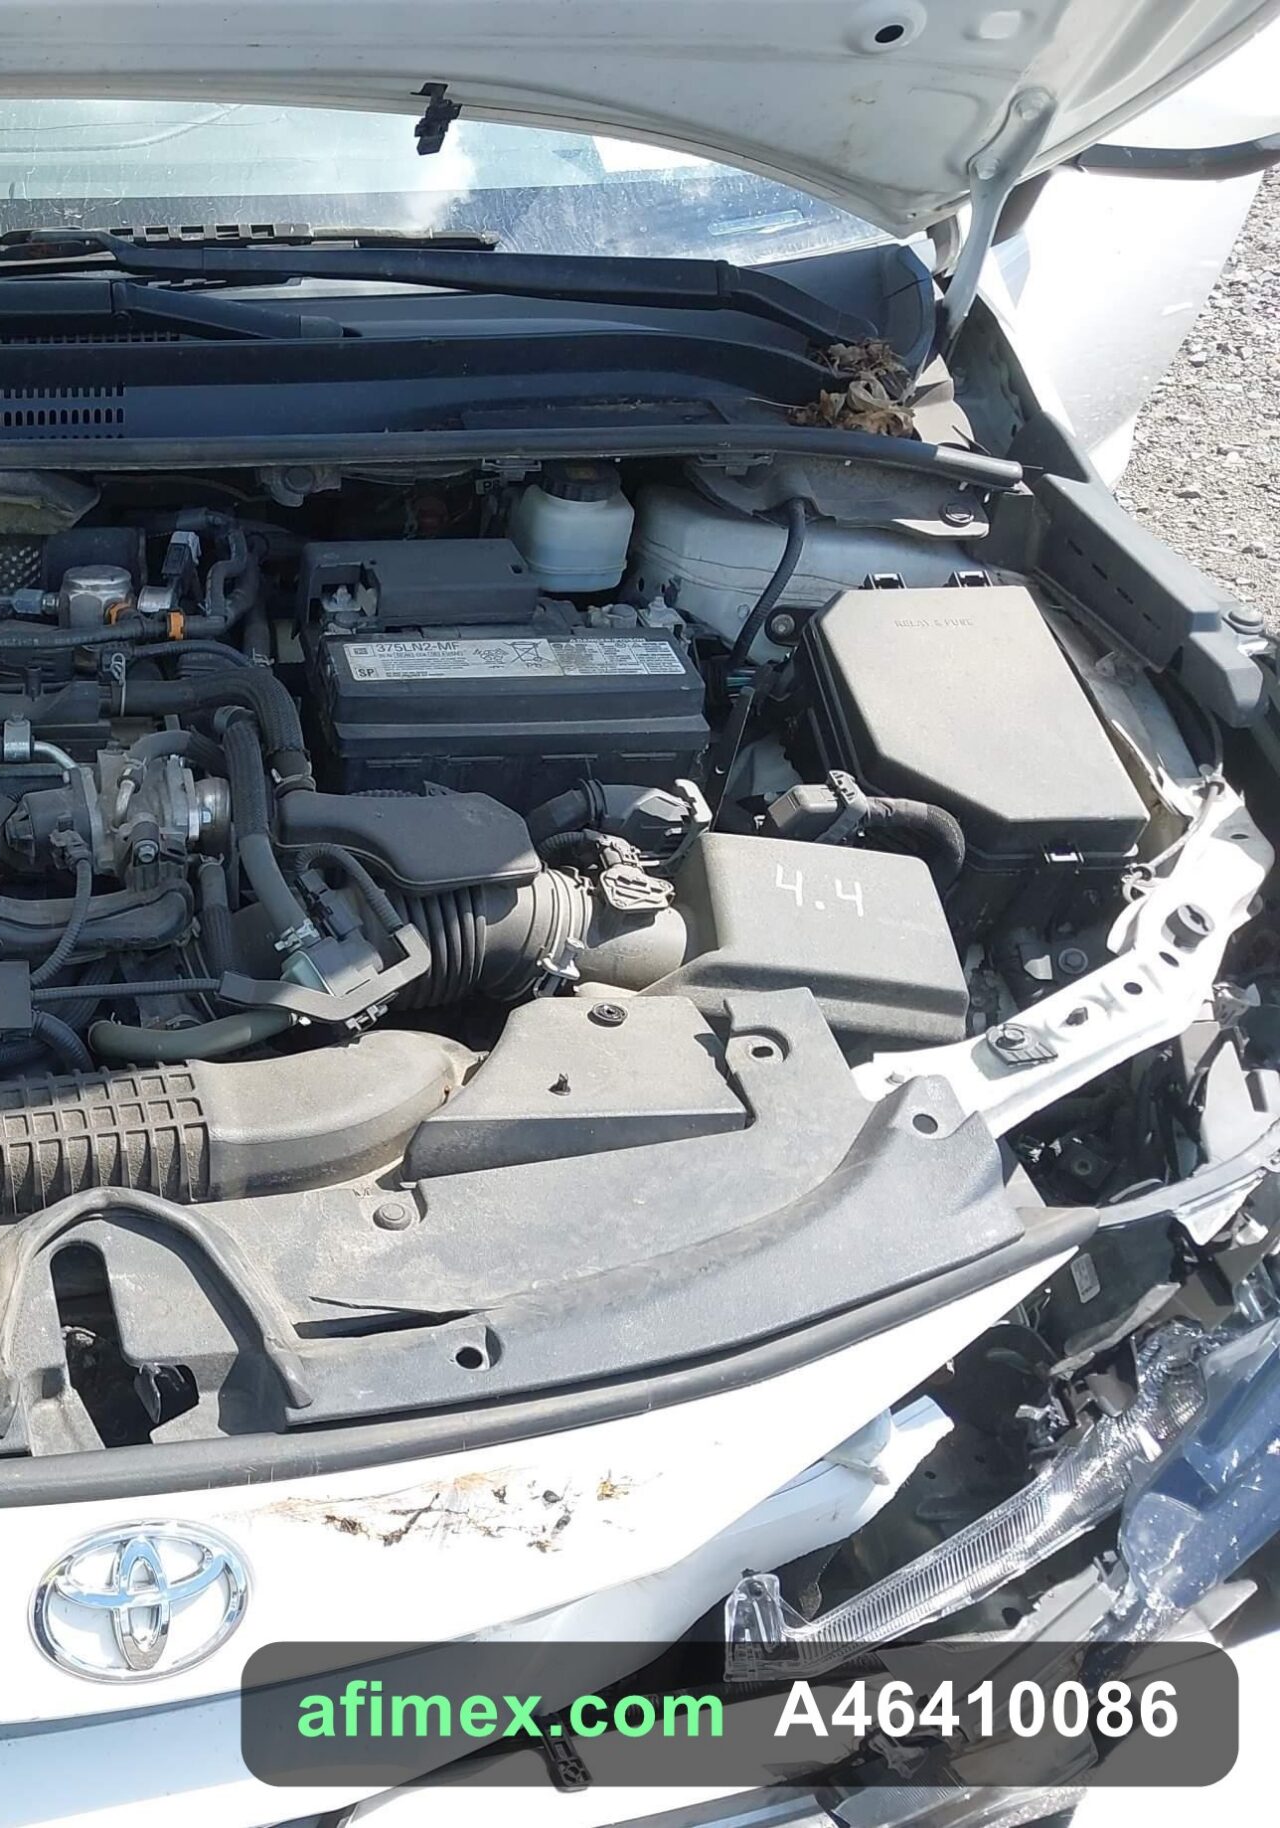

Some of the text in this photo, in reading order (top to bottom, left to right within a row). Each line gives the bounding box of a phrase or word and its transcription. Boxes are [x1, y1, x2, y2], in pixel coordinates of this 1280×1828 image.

[375, 641, 461, 653] 375LN2-MF
[357, 668, 375, 678] SP
[775, 863, 865, 918] 4.4
